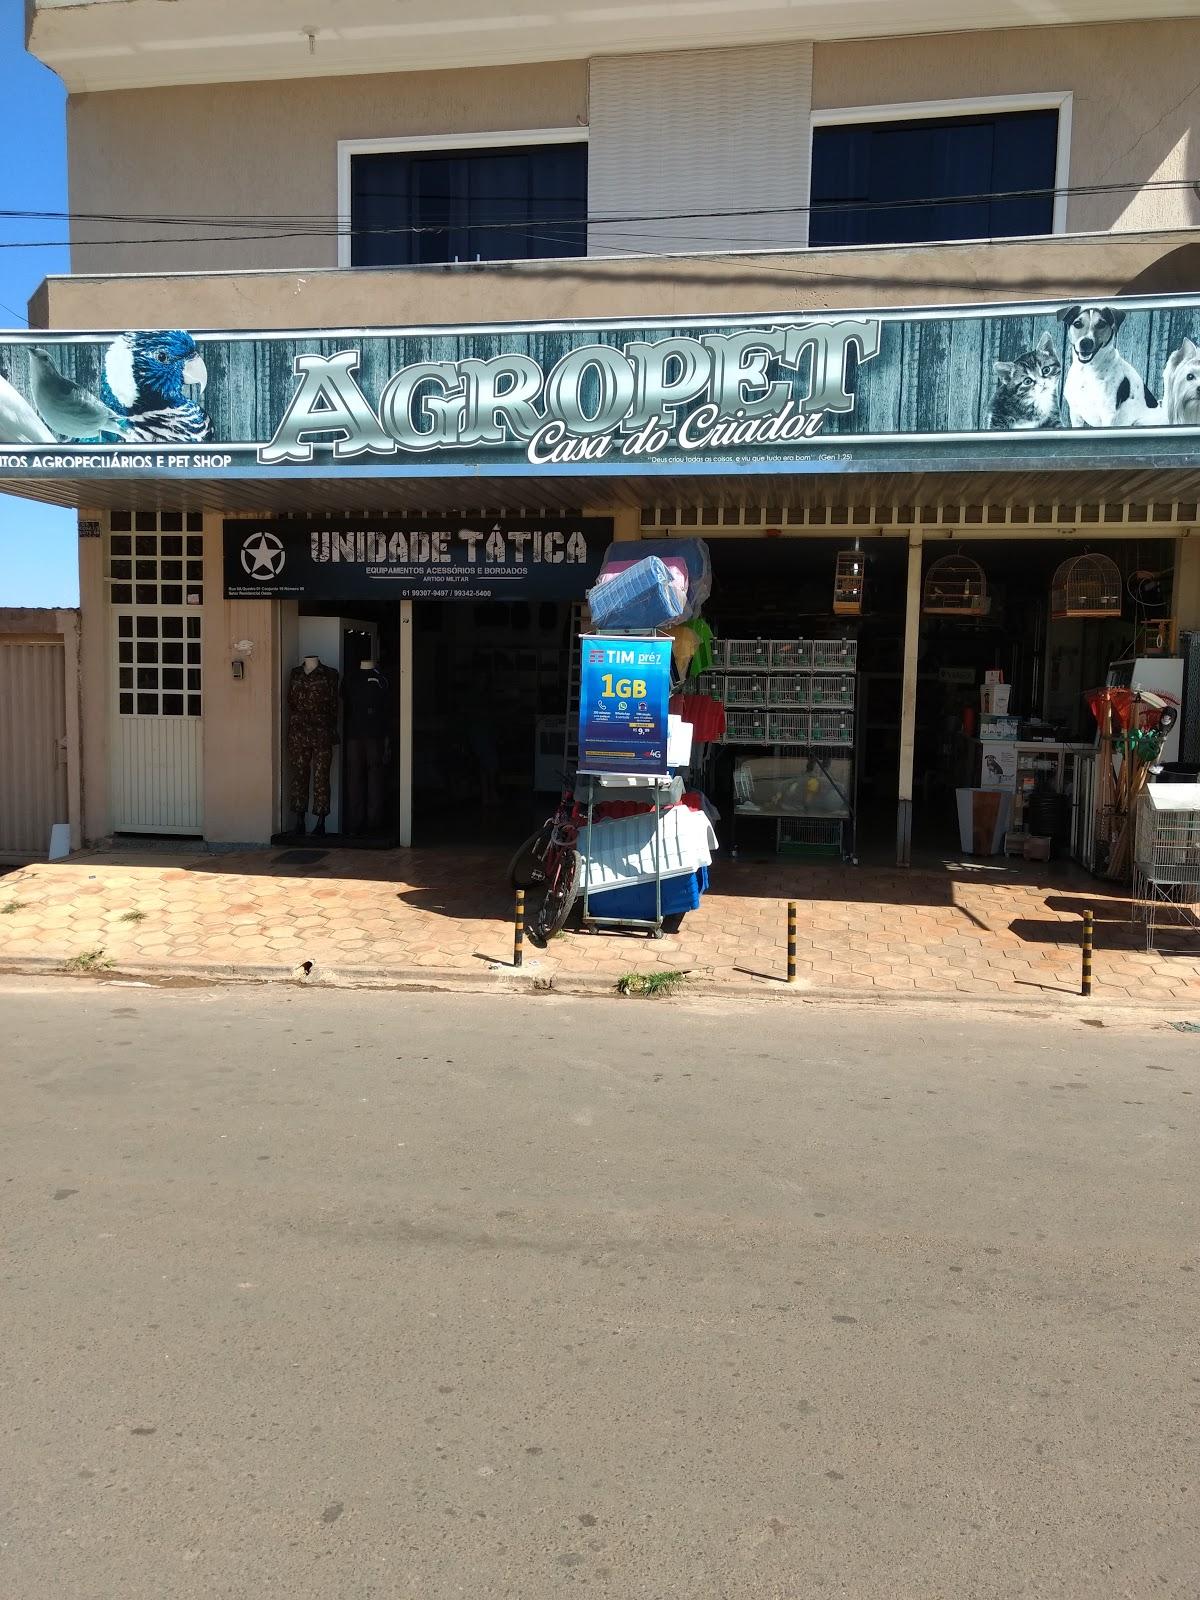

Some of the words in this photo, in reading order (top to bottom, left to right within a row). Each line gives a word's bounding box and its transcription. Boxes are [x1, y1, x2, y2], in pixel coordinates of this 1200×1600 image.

[256, 319, 882, 466] AGROPET
[526, 421, 613, 465] Casa
[622, 416, 670, 455] do
[678, 400, 825, 449] Criador
[32, 452, 152, 468] AGROPECUÁRIOS
[156, 455, 165, 468] E
[168, 455, 190, 468] PET
[193, 454, 232, 468] SHOP
[310, 531, 451, 563] UNIDADE
[458, 523, 588, 564] TÁTICA
[365, 567, 424, 575] EQUIPAMENTOS
[426, 565, 474, 575] ACESSÓRIOS
[484, 567, 528, 575] BORDADOS
[606, 650, 634, 664] TIM
[601, 673, 647, 698] 1GB
[650, 749, 661, 758] 4G
